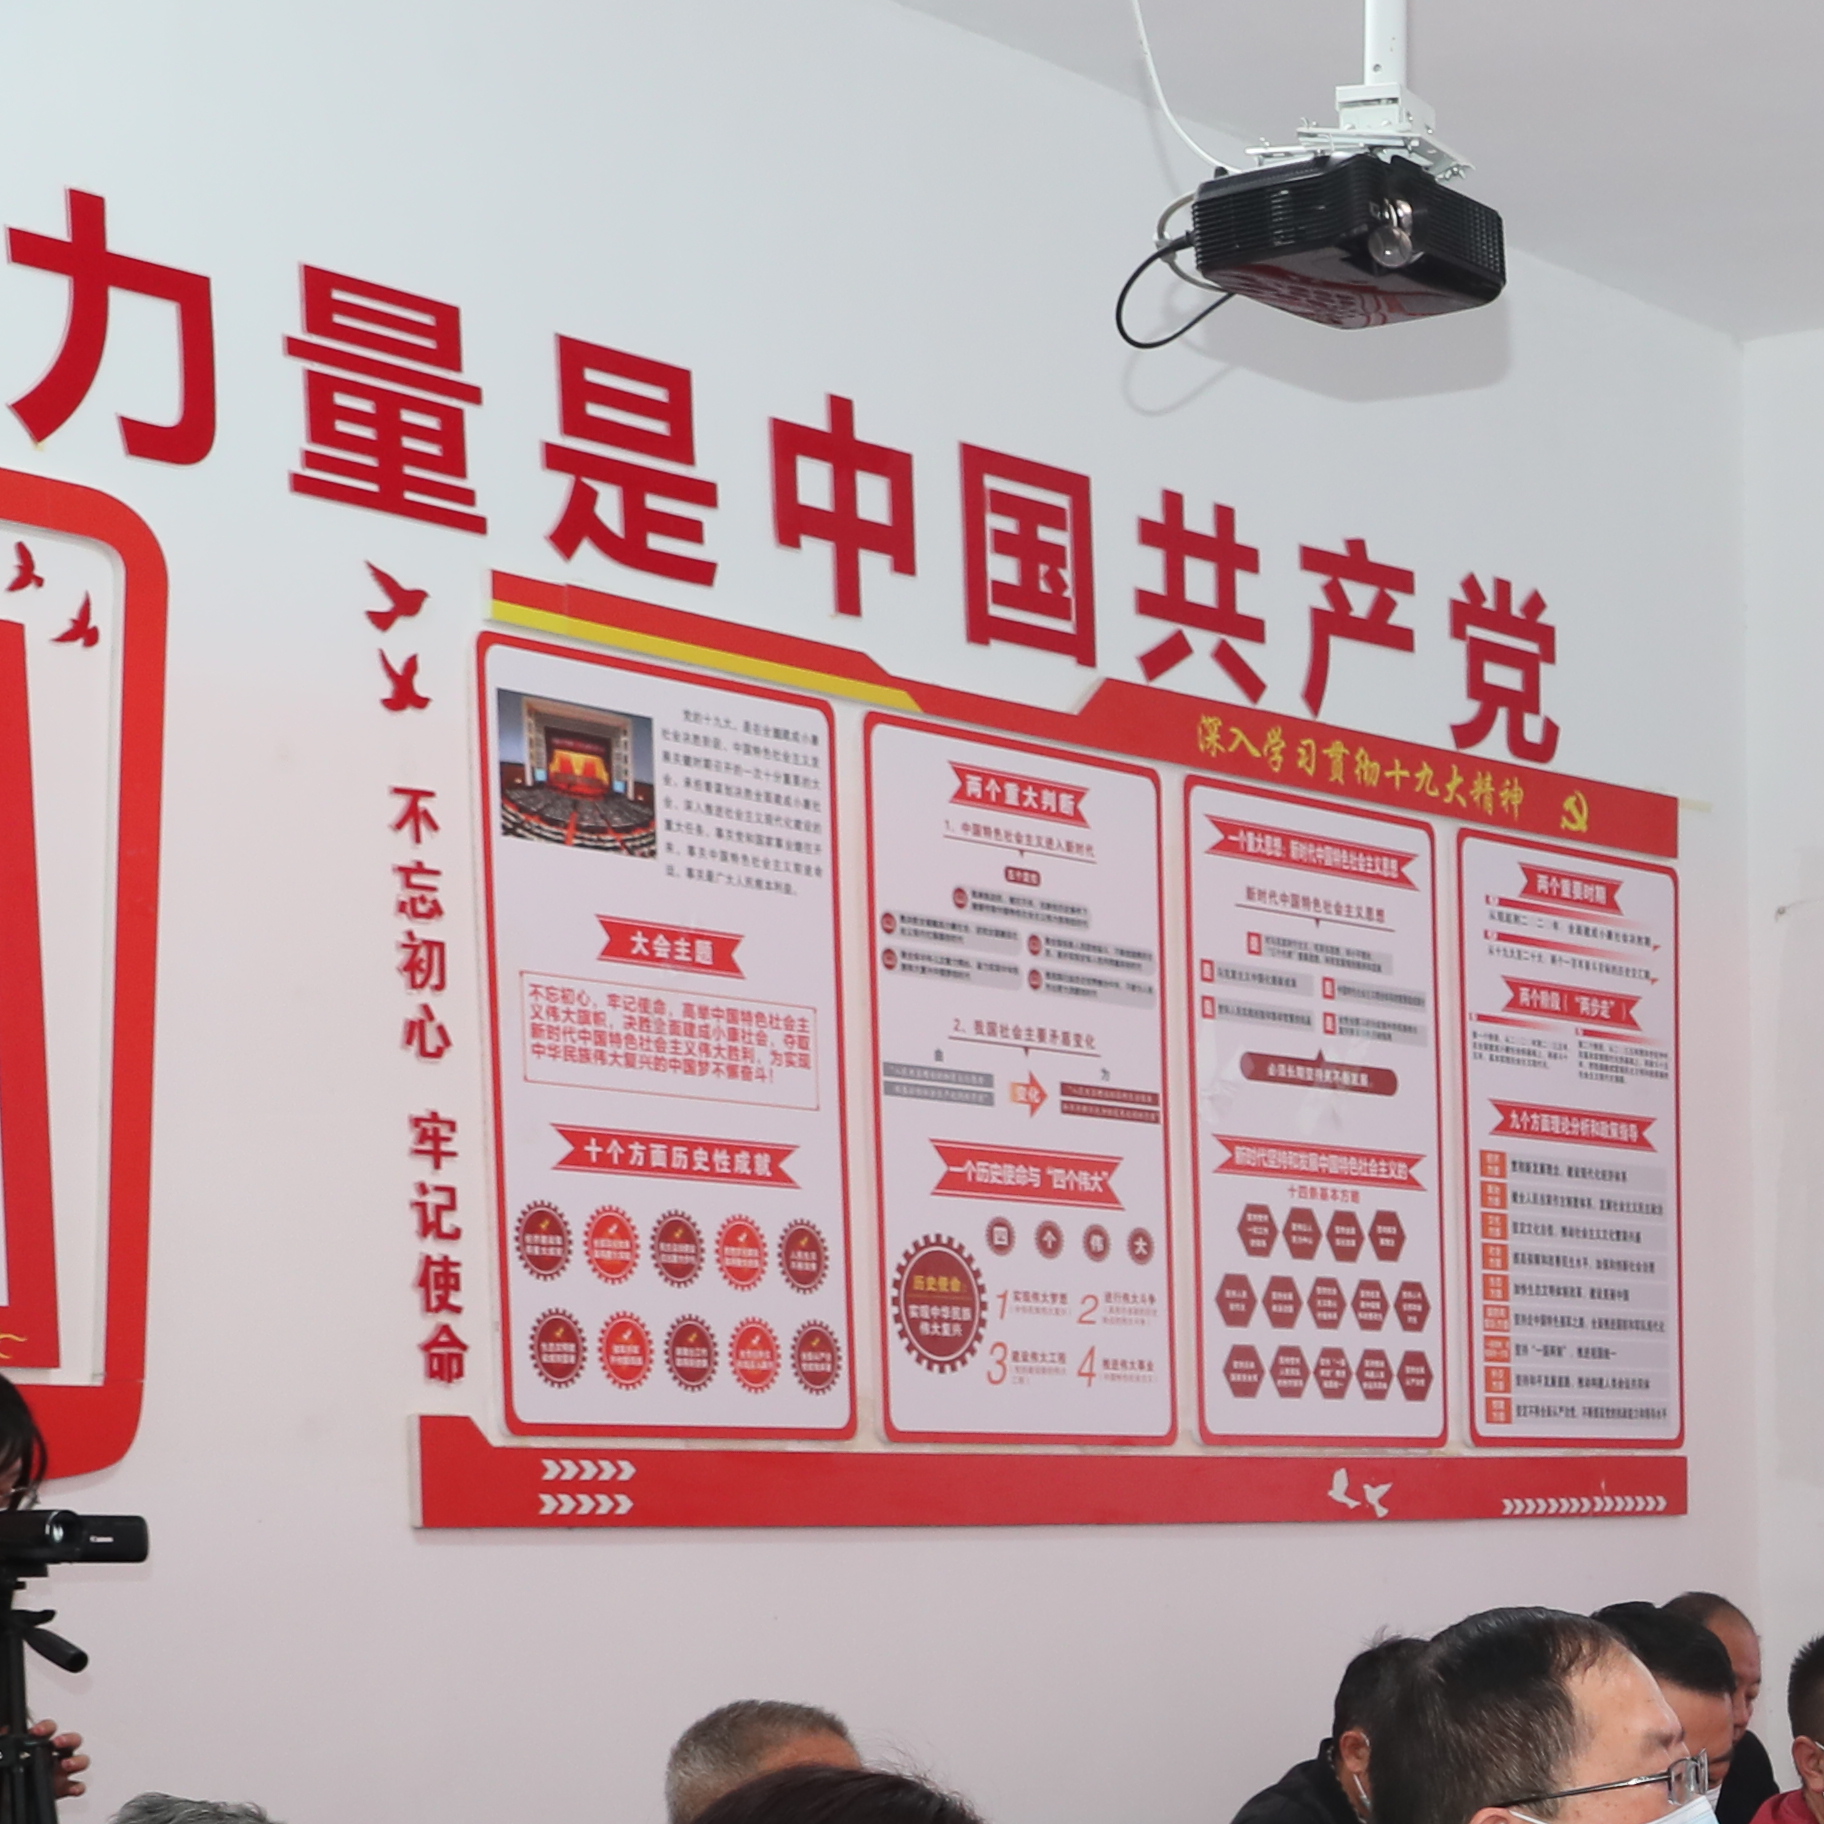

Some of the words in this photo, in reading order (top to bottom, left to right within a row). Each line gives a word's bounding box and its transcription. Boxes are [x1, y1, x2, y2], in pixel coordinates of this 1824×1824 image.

[6, 187, 1560, 765] 力量是中国共产党
[965, 774, 1075, 817] 两个重大判断
[1246, 886, 1386, 924] 新时代中国特色社会主义思想
[1536, 874, 1608, 905] 两个重要时期
[390, 785, 454, 1061] 不忘初心
[630, 930, 715, 966] 大会主题
[1015, 1086, 1041, 1105] 变化
[584, 1137, 773, 1177] 十个方面历史性成就
[407, 1109, 470, 1386] 牢记使命
[993, 1226, 1009, 1246] 四
[1043, 1230, 1057, 1249] 个
[1134, 1237, 1148, 1256] 大
[908, 1304, 972, 1322] 实现中华民族
[996, 1289, 1009, 1320] 1
[1076, 1294, 1100, 1325] 2
[919, 1322, 963, 1337] 伟大复兴
[986, 1341, 1009, 1385] 3
[1077, 1345, 1097, 1388] 4
